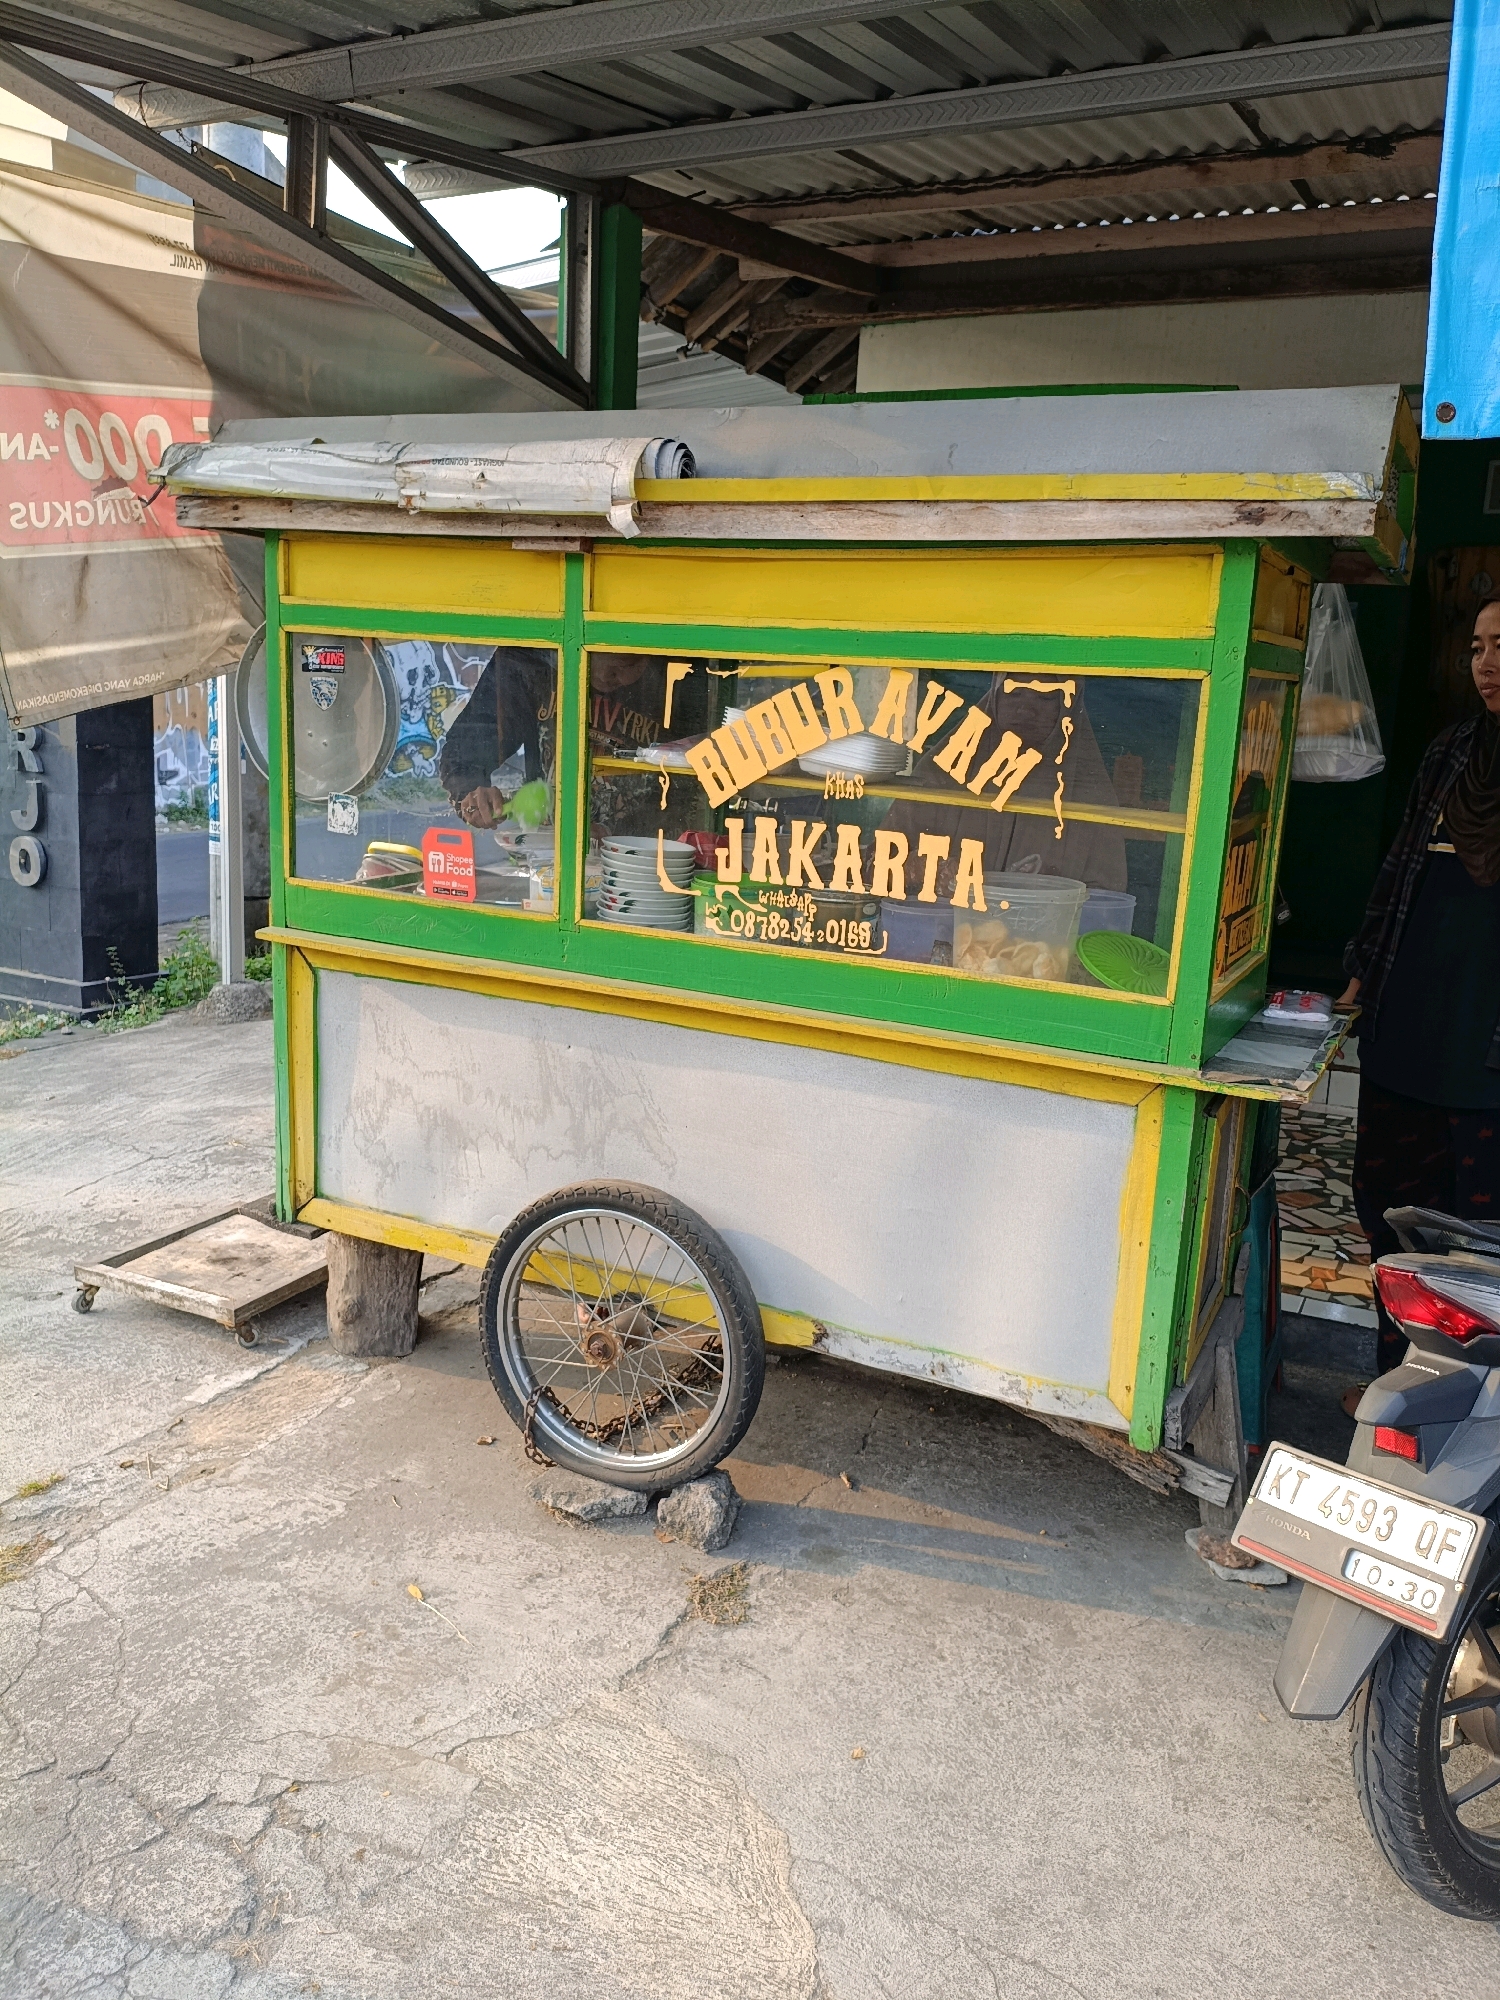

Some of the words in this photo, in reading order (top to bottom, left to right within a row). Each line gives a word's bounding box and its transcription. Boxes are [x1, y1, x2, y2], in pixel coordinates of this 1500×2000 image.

[318, 652, 345, 665] KING
[684, 667, 865, 809] BUBUR
[869, 667, 1043, 812] AYAM
[446, 853, 474, 865] Shopee
[446, 862, 474, 877] Food
[1405, 1362, 1440, 1376] HONDA
[1267, 1463, 1310, 1504] KT
[1317, 1485, 1398, 1542] 4593
[1414, 1520, 1462, 1564] QF
[1265, 1514, 1311, 1541] HONDA
